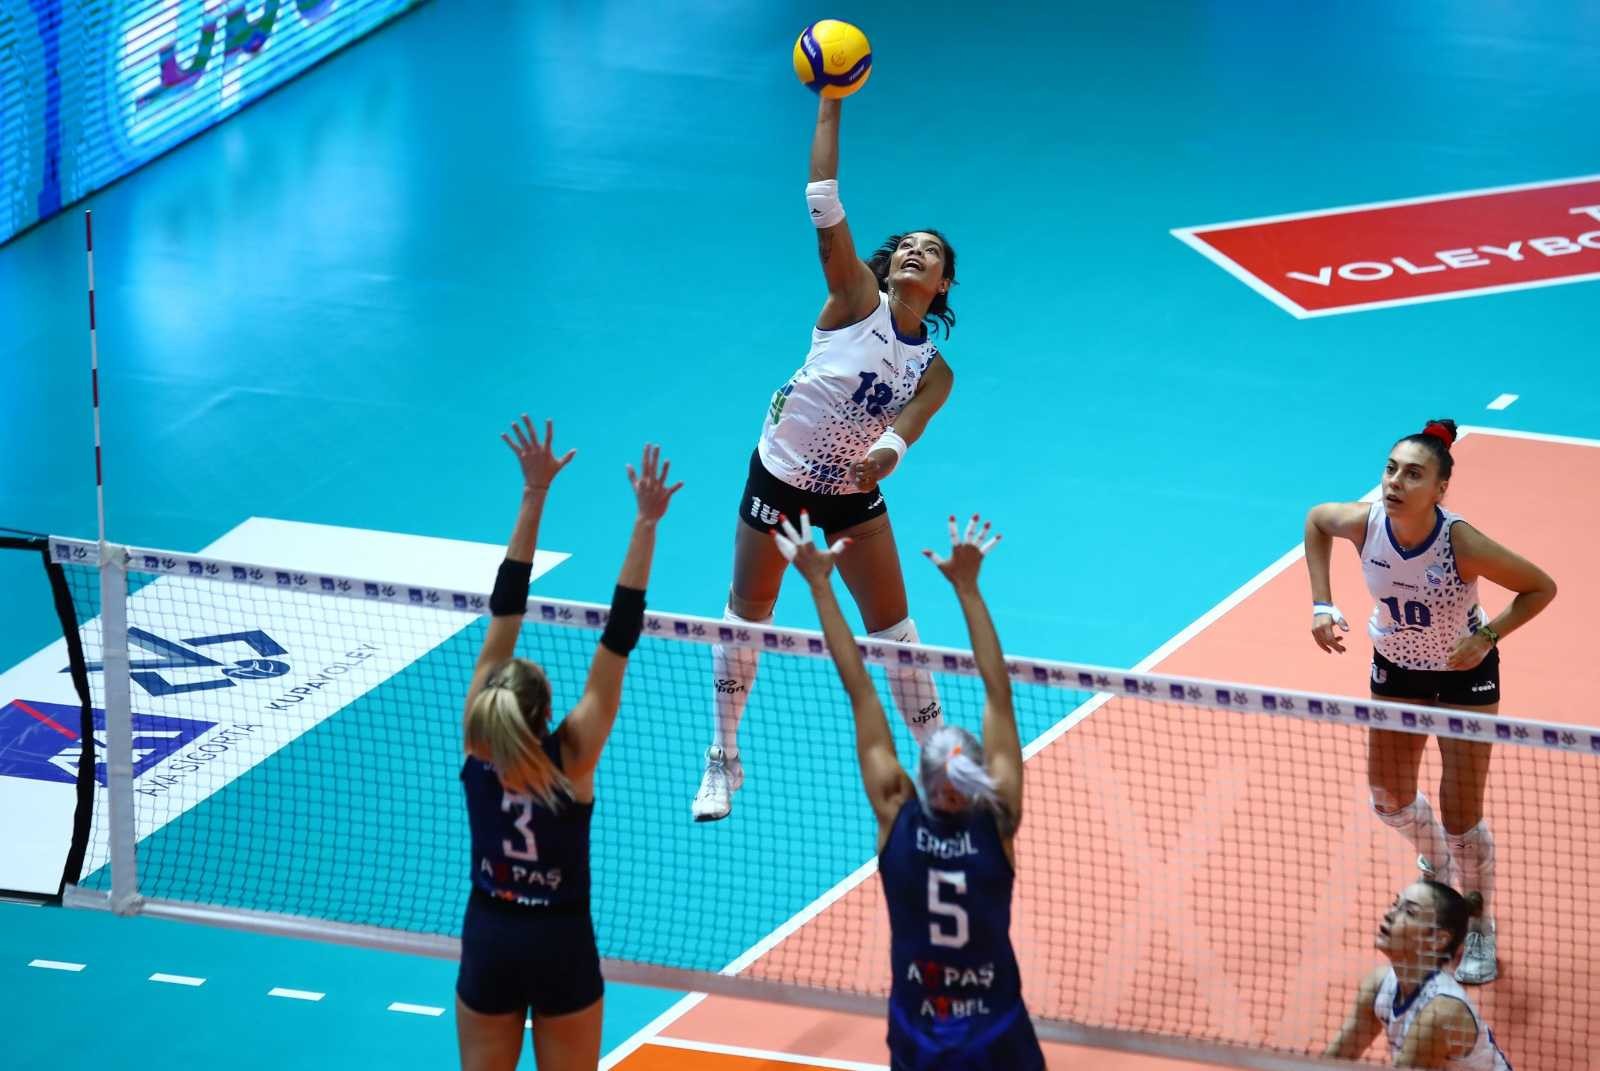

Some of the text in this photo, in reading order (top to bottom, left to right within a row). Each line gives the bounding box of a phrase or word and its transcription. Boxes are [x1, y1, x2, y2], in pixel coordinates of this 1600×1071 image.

[1380, 597, 1431, 627] 10
[501, 791, 538, 861] 3
[928, 868, 969, 950] 5
